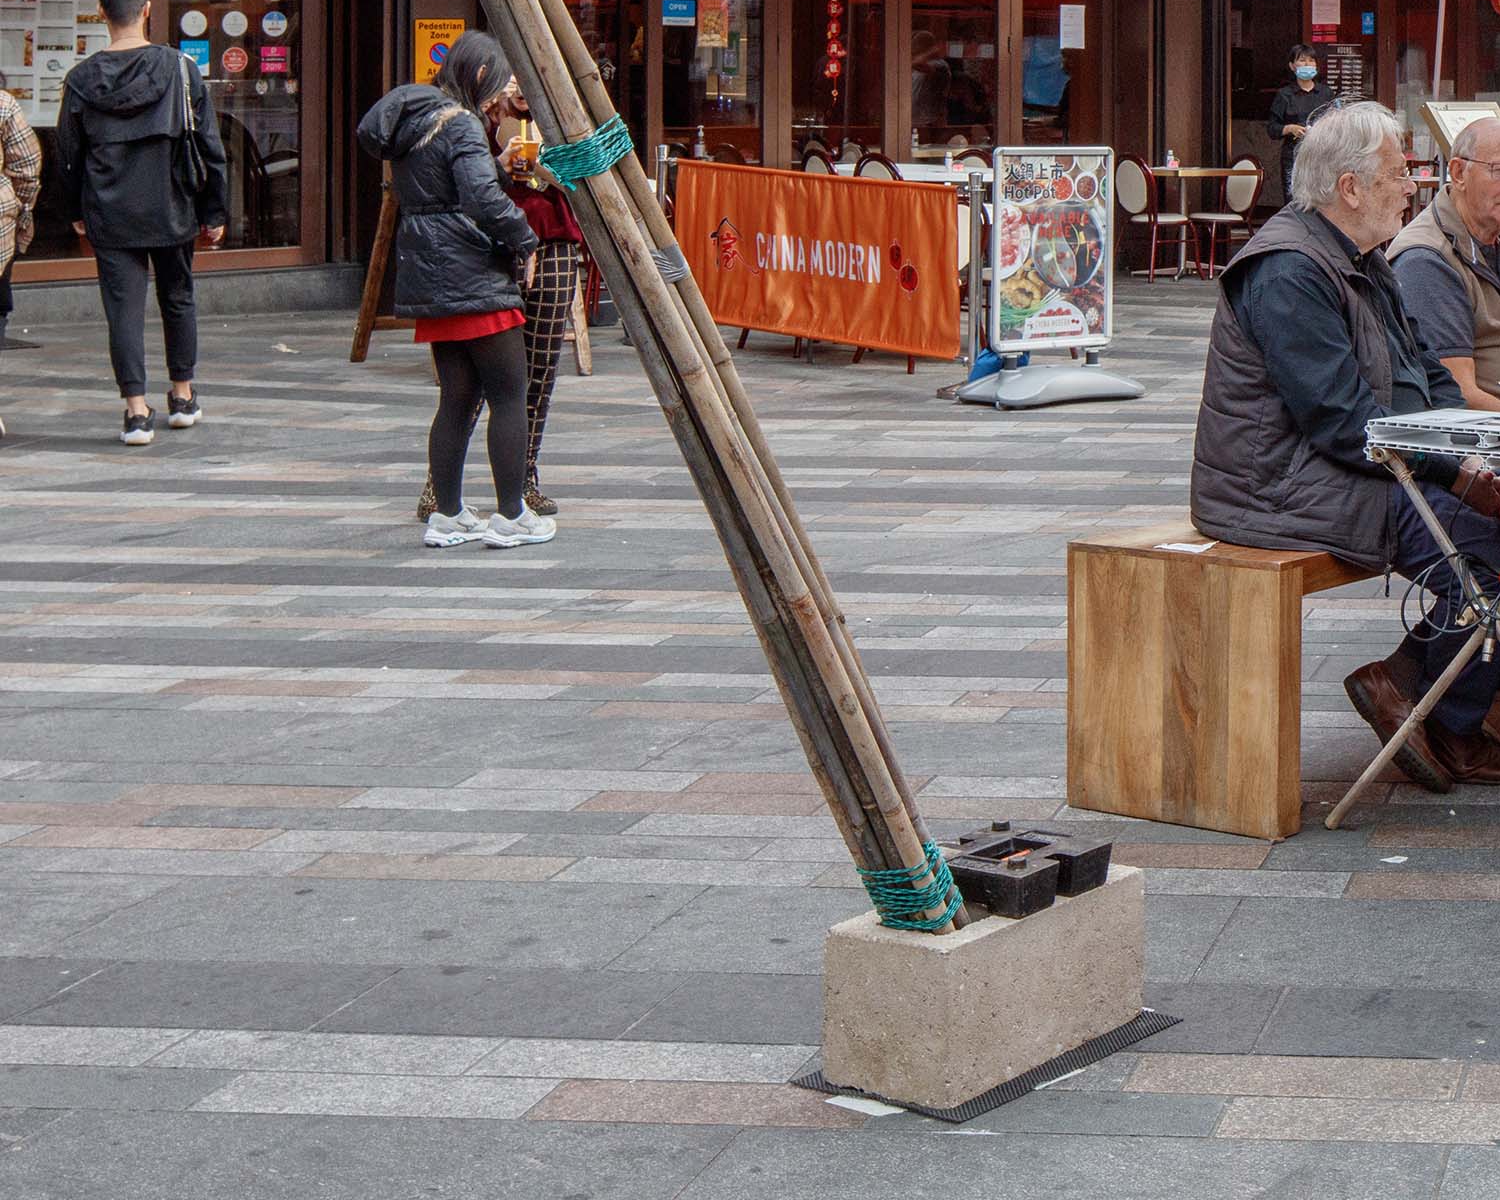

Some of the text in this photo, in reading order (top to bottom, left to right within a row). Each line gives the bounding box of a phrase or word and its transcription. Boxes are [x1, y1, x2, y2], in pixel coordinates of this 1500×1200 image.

[668, 3, 688, 11] OPEN
[418, 22, 462, 30] Pedestrian
[430, 31, 450, 39] Zone
[1004, 163, 1064, 180] 火鍋上市
[1004, 185, 1056, 199] Hot Pot
[810, 239, 881, 284] MODERN
